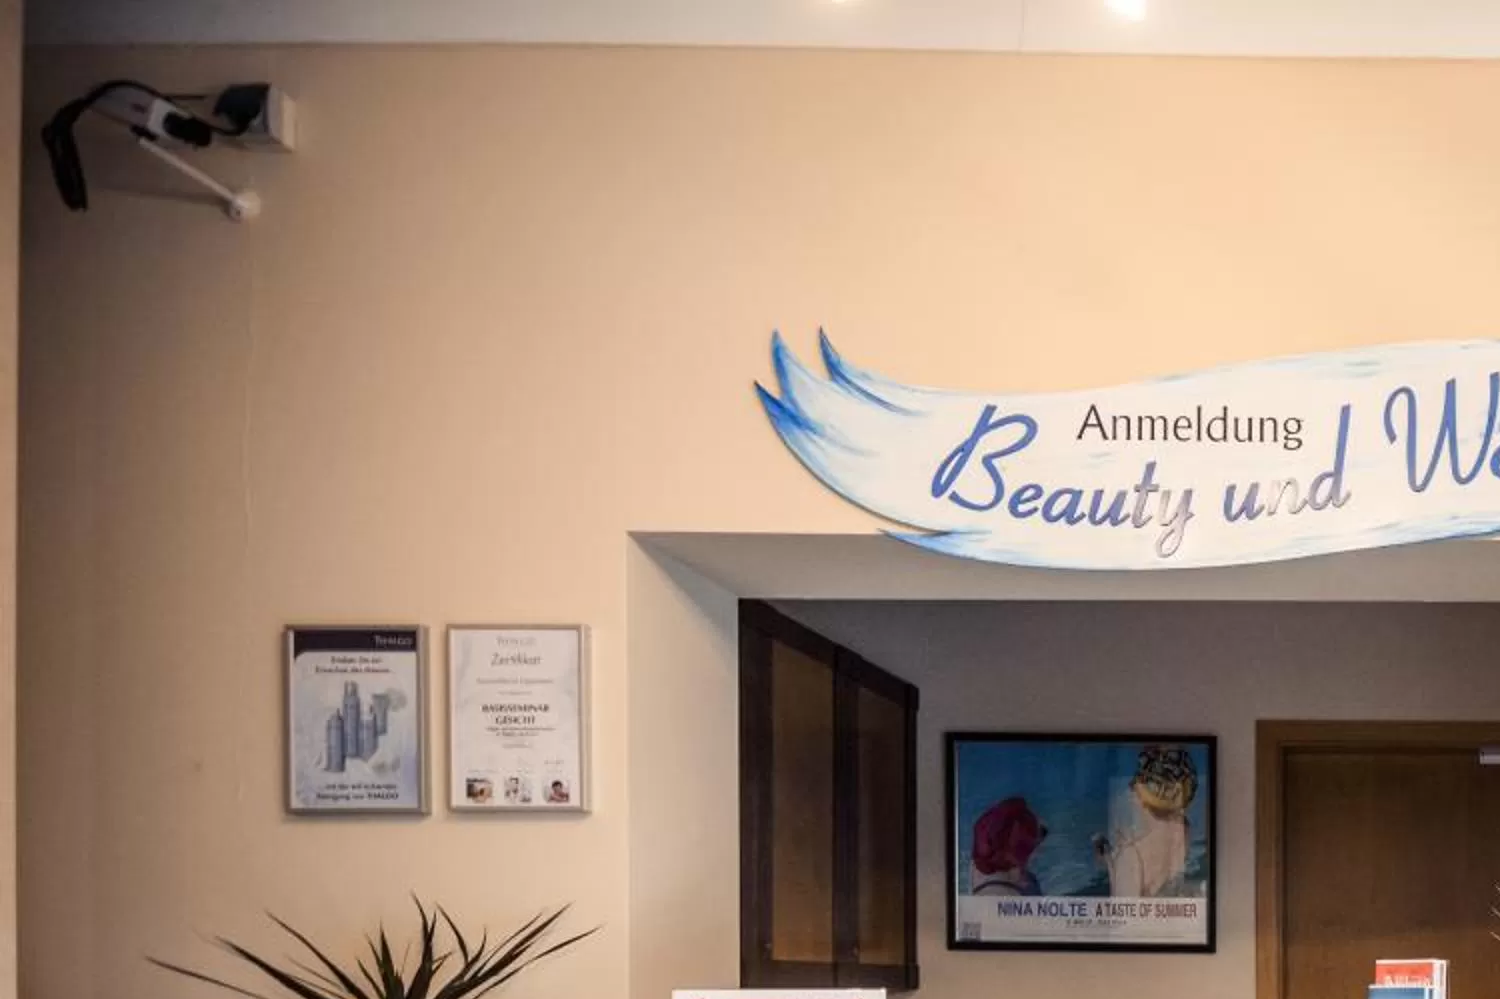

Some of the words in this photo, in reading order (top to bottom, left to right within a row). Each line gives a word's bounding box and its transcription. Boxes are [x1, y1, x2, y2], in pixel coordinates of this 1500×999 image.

[1077, 404, 1304, 451] Anmeldung
[931, 404, 1196, 558] Beauty
[1223, 403, 1353, 518] und
[997, 902, 1033, 917] NINA
[1037, 902, 1087, 917] NOLTE
[1095, 903, 1103, 917] A
[1105, 903, 1137, 917] TASTE
[1139, 903, 1153, 917] OF
[1155, 903, 1198, 917] SUMMER
